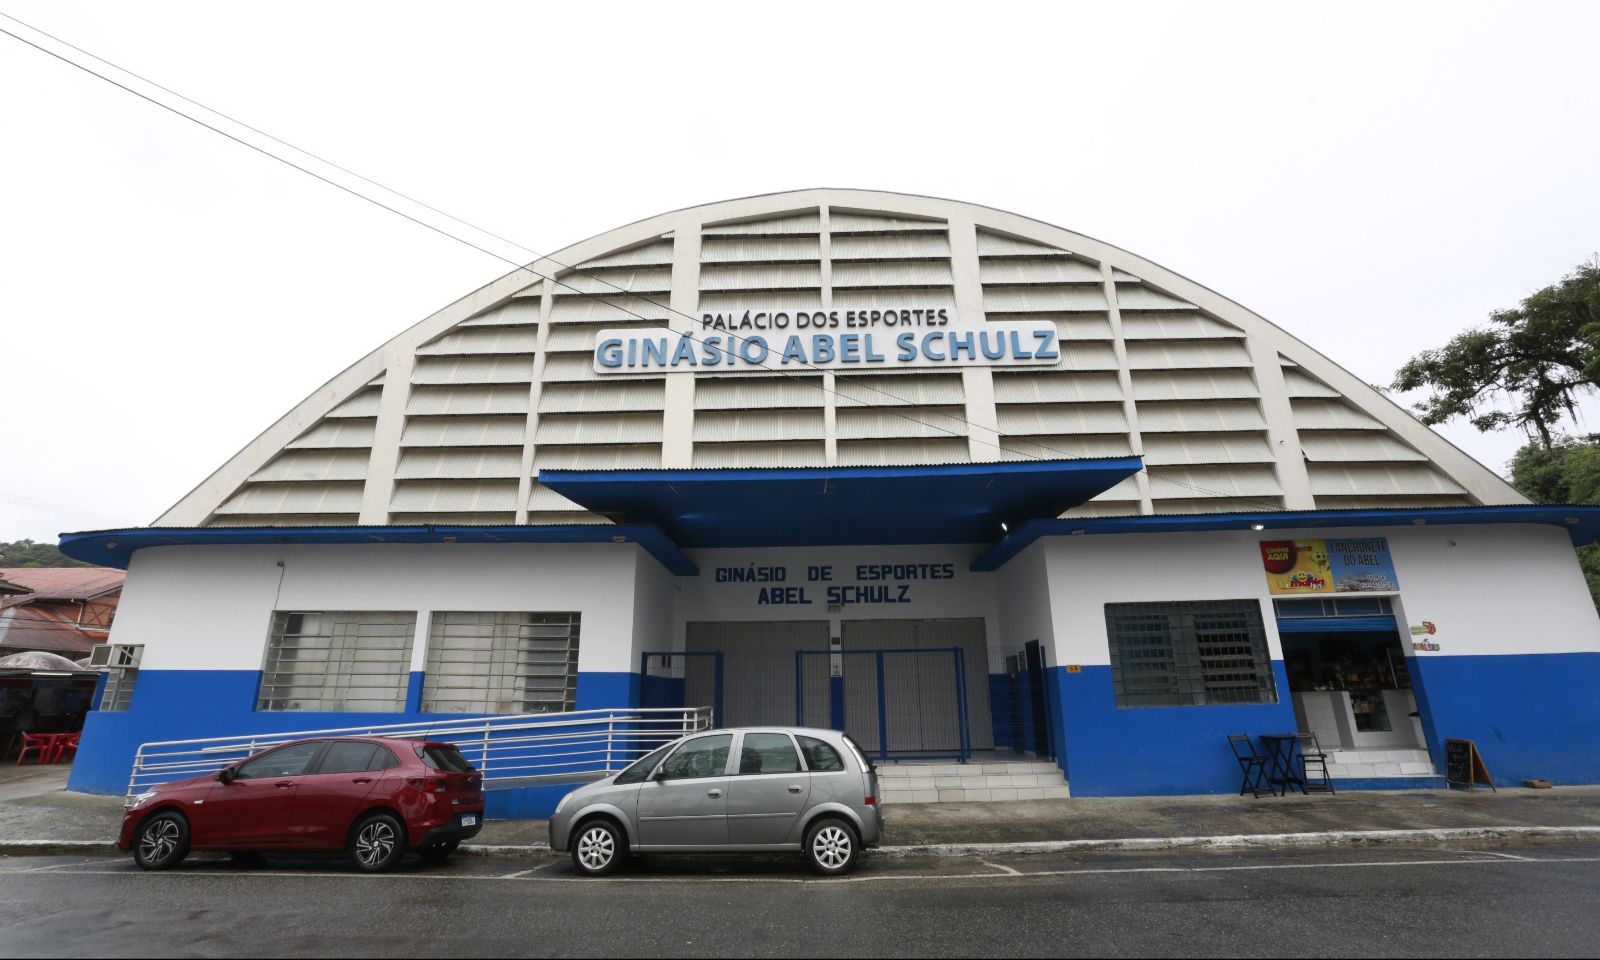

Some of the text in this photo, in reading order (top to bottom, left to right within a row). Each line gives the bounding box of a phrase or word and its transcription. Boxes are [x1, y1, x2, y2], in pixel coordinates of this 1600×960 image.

[702, 308, 949, 330] PALÁCIO DOS ESPORTES
[596, 330, 1059, 367] GINÁSIO ABEL SCHULZ
[1267, 553, 1289, 561] AQUI
[1330, 541, 1387, 553] LANCHONETE
[1344, 554, 1381, 567] DO ABEL
[715, 562, 954, 583] GINÁSIO DE ESPORTES
[758, 585, 911, 605] ABEL SCHULZ
